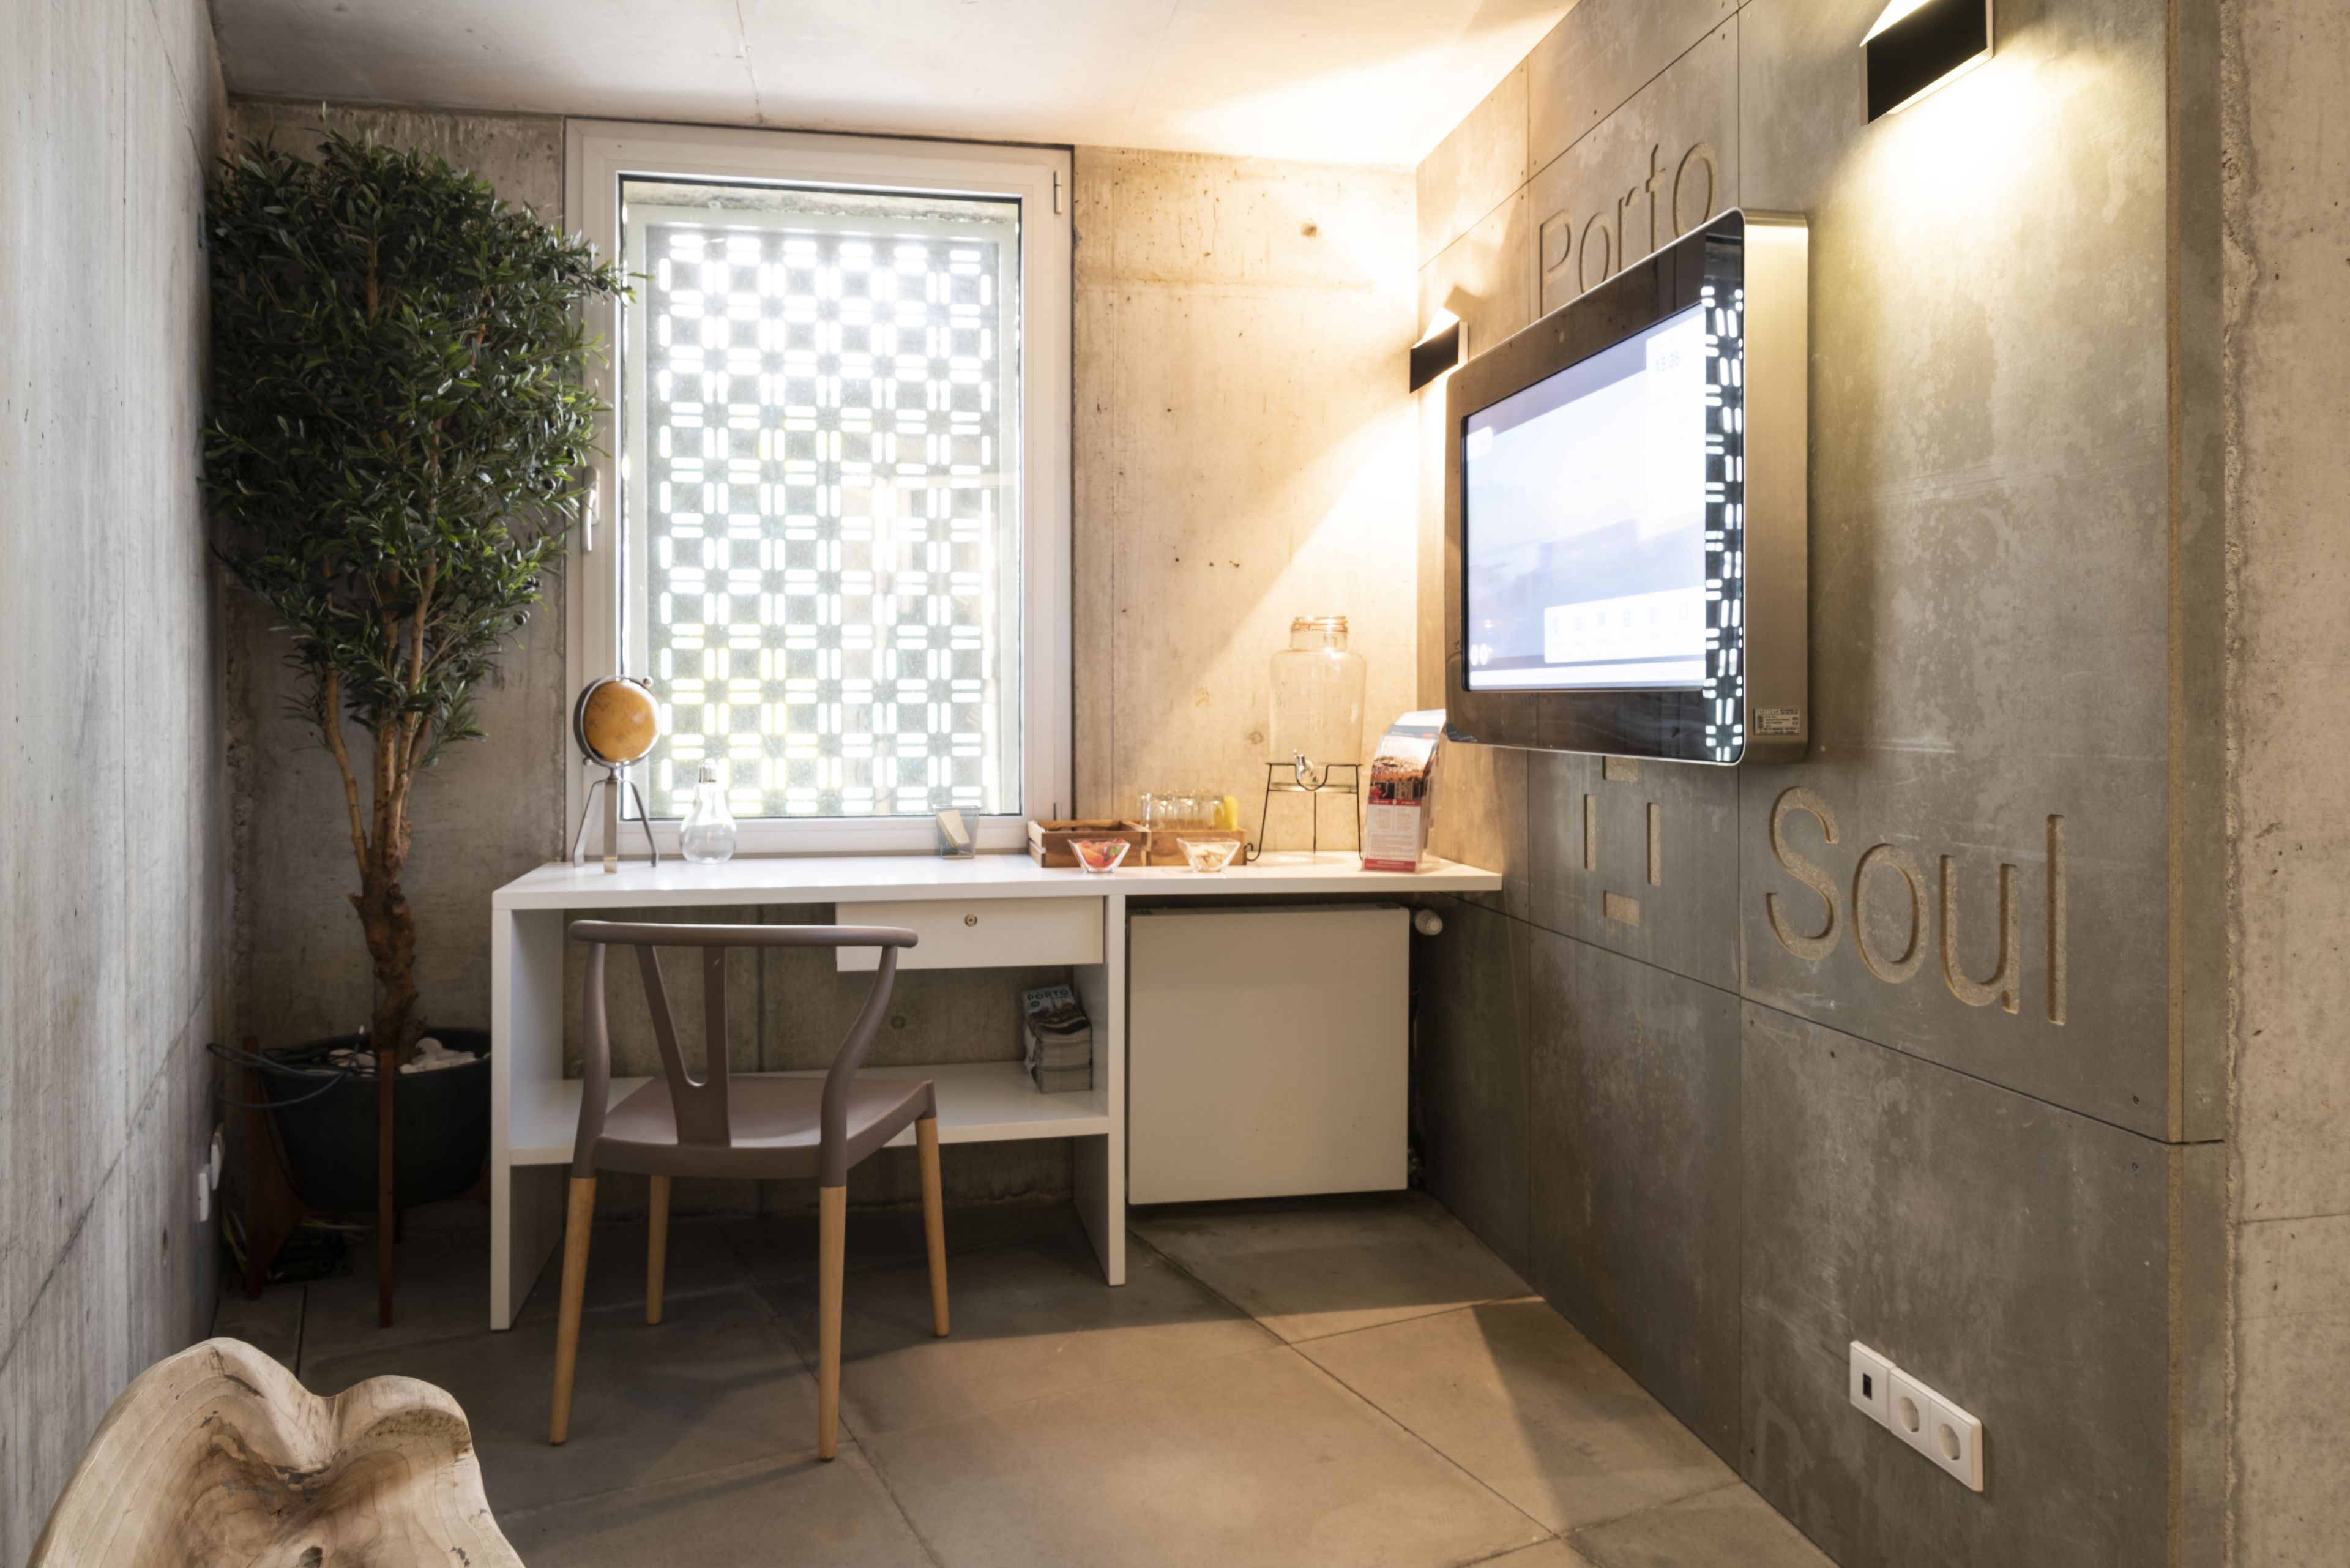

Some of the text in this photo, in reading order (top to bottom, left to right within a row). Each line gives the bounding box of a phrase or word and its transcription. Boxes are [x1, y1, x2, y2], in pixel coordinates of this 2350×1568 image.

[1539, 141, 1718, 317] Porto
[1766, 786, 2067, 1026] Soul
[1028, 989, 1069, 1001] PORTO
